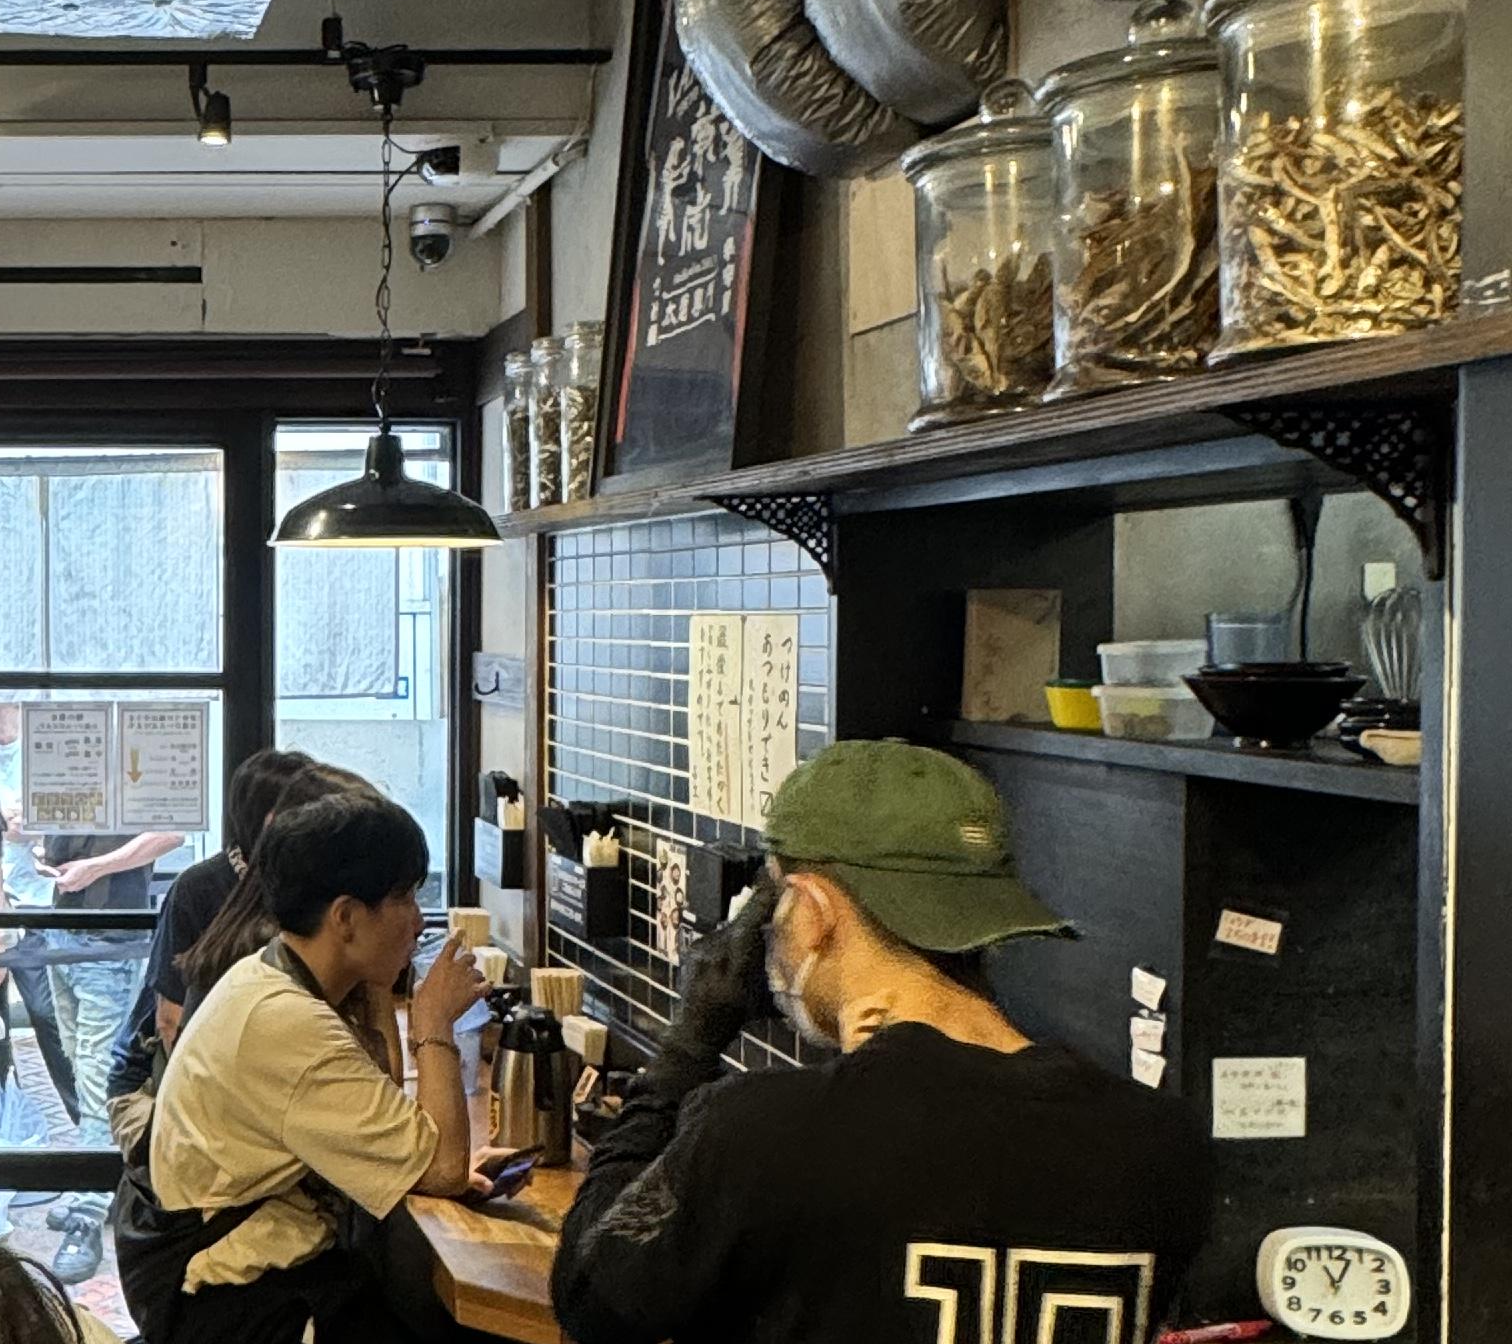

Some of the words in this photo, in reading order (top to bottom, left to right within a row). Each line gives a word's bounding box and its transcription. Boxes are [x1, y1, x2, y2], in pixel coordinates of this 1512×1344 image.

[776, 636, 792, 731] つけめん
[1286, 1257, 1306, 1272] 10
[1370, 1258, 1385, 1273] 2
[1282, 1276, 1296, 1290] 9
[1376, 1279, 1391, 1294] 3
[1286, 1296, 1301, 1311] 8
[1373, 1301, 1387, 1316] 4
[1308, 1308, 1322, 1322] 7
[1329, 1311, 1345, 1325] 6
[1353, 1311, 1367, 1325] 5
